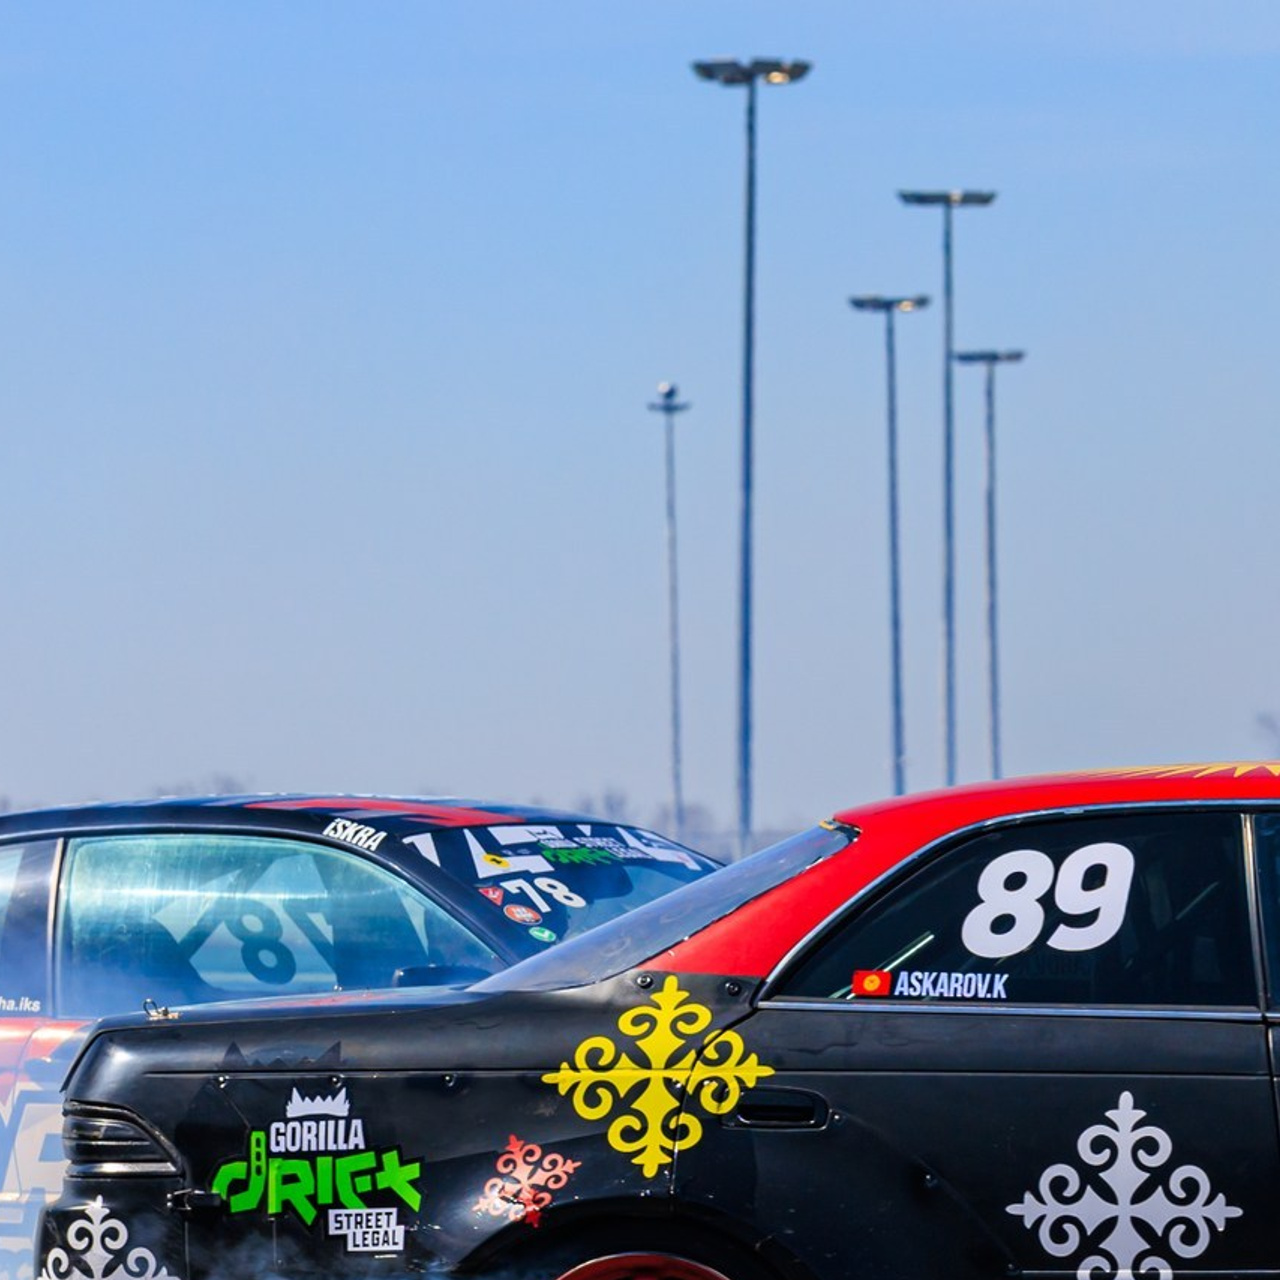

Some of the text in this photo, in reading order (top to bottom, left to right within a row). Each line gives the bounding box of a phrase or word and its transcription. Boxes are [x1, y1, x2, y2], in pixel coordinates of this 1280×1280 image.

[500, 877, 587, 913] 78
[961, 842, 1135, 958] 89
[894, 971, 1009, 998] ASKAROV.K
[270, 1119, 365, 1153] GORILLA
[334, 1212, 393, 1230] STREET
[352, 1231, 399, 1247] LEGAL
